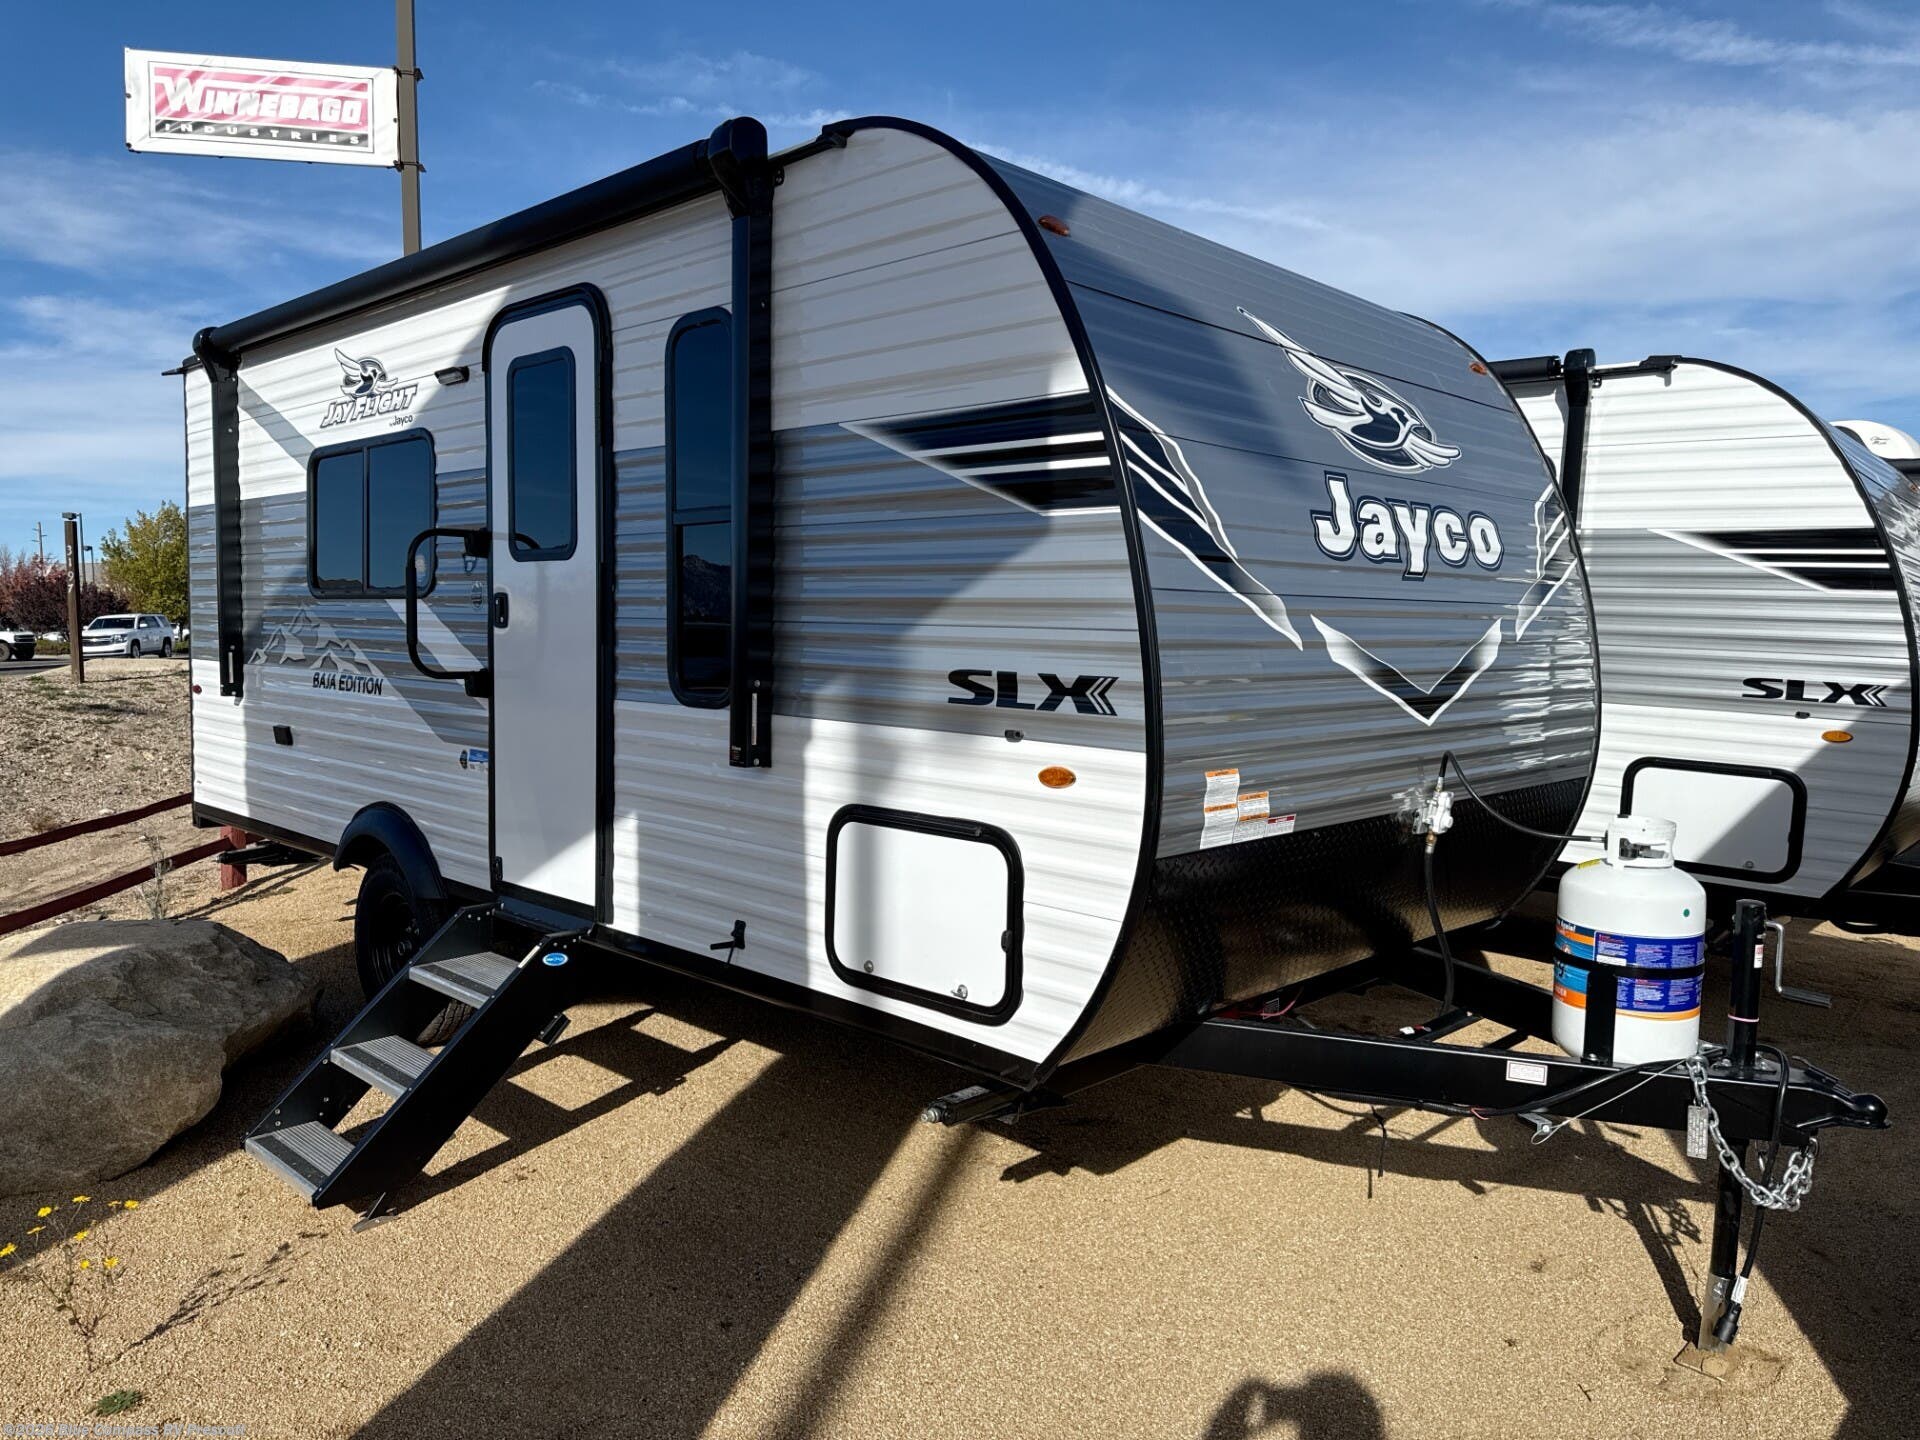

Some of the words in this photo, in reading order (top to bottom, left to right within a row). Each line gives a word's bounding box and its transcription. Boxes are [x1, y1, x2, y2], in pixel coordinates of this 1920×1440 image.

[160, 76, 362, 125] WINNEBAGO
[164, 122, 360, 146] INDUSTRIES
[320, 401, 356, 428] JAY
[351, 383, 418, 421] FLIGHT
[393, 415, 413, 427] Jayco
[1311, 471, 1504, 581] Jayco
[66, 545, 74, 593] 3197
[312, 672, 337, 690] BAJA
[338, 674, 383, 696] EDITION
[948, 669, 1119, 716] SLX
[1742, 677, 1888, 707] SLX
